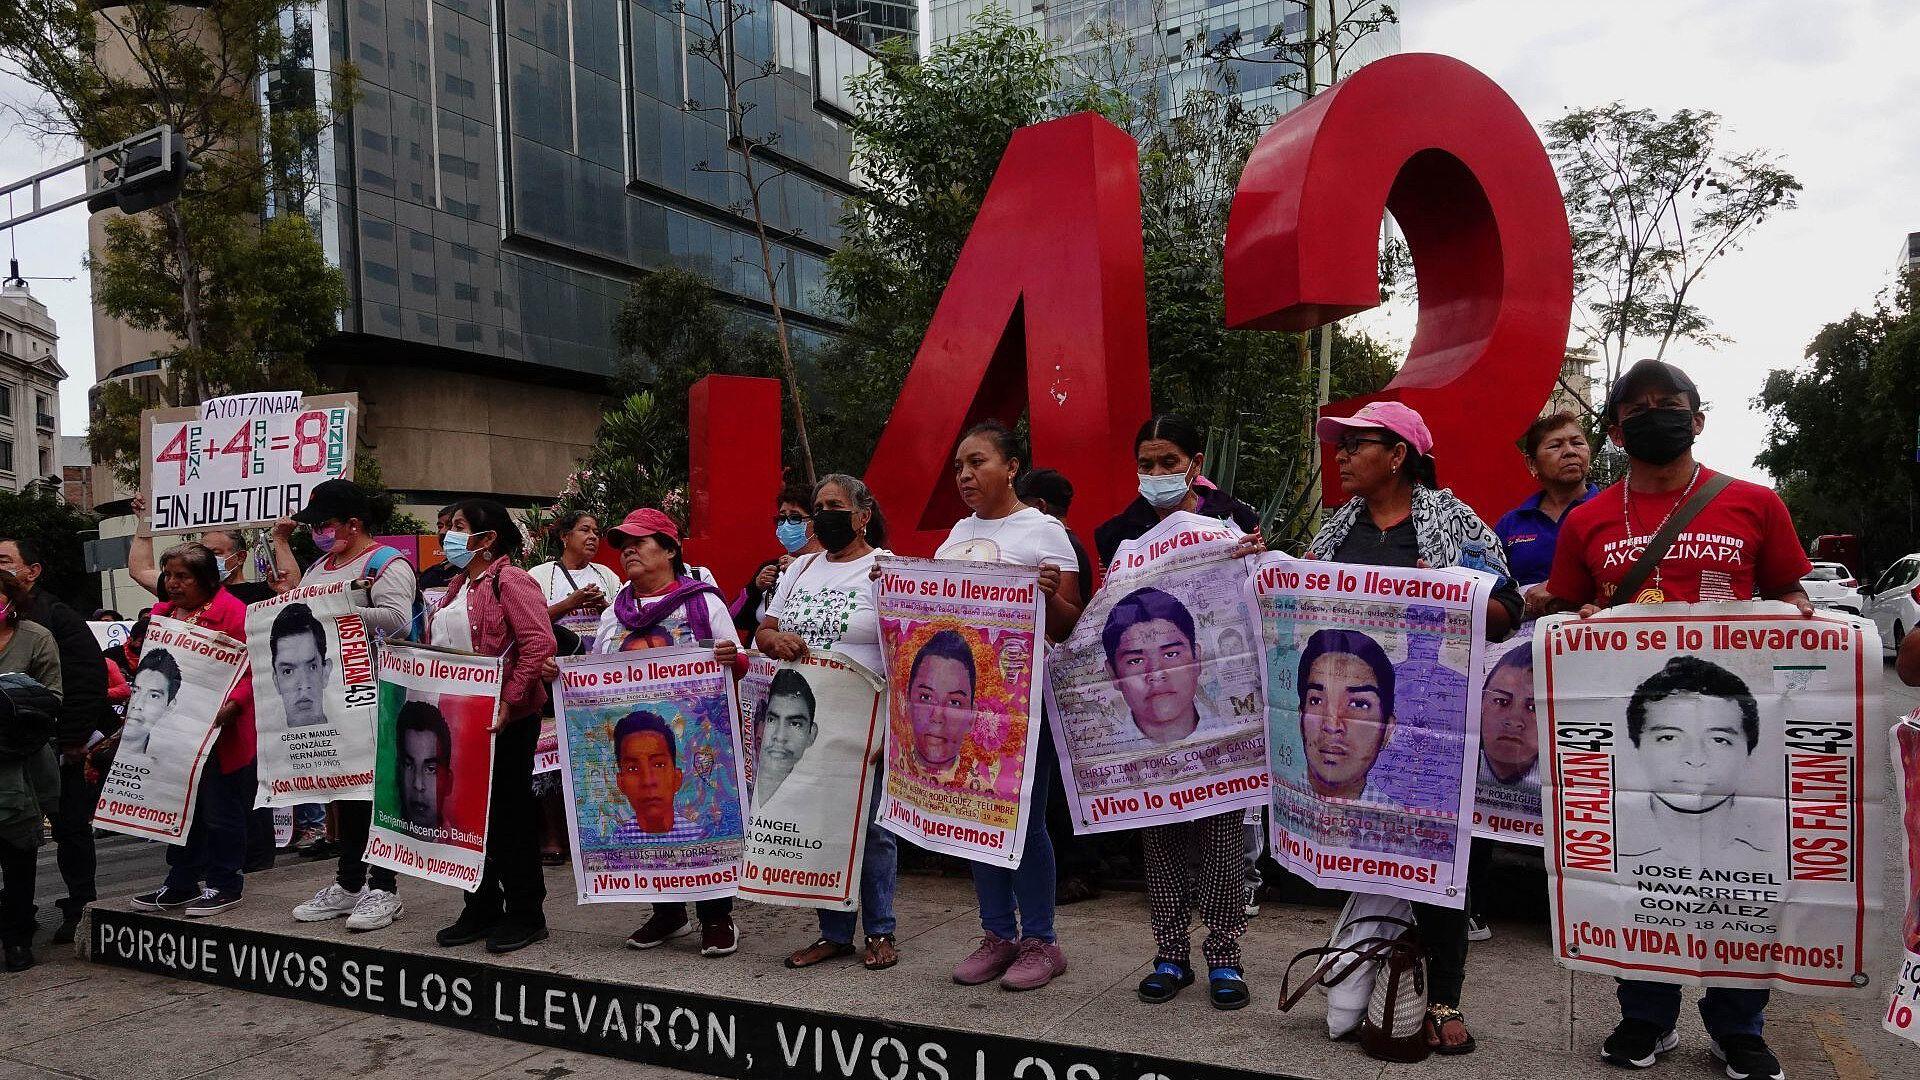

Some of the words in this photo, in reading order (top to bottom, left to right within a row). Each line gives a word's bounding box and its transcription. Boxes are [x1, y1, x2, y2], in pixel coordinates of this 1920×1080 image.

[293, 411, 328, 474] 8
[155, 494, 190, 528] SIN
[193, 484, 302, 525] JUSTICIA
[1127, 553, 1144, 569] lo
[1149, 529, 1234, 561] llevaron!
[1603, 544, 1742, 569] AYOZINAPA
[1604, 541, 1617, 552] NI
[1677, 532, 1693, 542] NI
[1696, 533, 1744, 549] OLVIDO
[880, 573, 916, 596] ¡Vivo
[920, 580, 938, 596] se
[943, 578, 956, 598] lo
[961, 579, 1034, 604] llevaron!
[1257, 567, 1299, 595] ¡Vivo
[1304, 572, 1330, 591] se
[1337, 570, 1357, 593] lo
[1364, 571, 1471, 603] llevaron!
[336, 614, 365, 640] NOS
[1555, 626, 1628, 656] ¡Vivo
[1636, 629, 1667, 651] se
[1677, 625, 1703, 651] lo
[1713, 624, 1849, 651] llevaron!
[150, 629, 160, 641] se
[162, 631, 173, 644] lo
[174, 634, 241, 666] llevaron!
[342, 640, 373, 686] FALTAN
[379, 651, 401, 672] ¡Vivo
[402, 659, 411, 674] se
[412, 660, 425, 676] lo
[429, 659, 500, 684] llevaron!
[562, 671, 598, 691] ¡Vivo
[603, 670, 622, 685] se
[628, 665, 643, 682] lo
[647, 659, 721, 680] llevaron!
[345, 684, 377, 709] 43!
[281, 732, 307, 742] CÉSAR
[308, 729, 340, 739] MANUEL
[289, 739, 332, 750] GONZÁLEZ
[1557, 721, 1614, 753] 43!
[1785, 720, 1853, 754] 43!
[289, 749, 338, 760] HERNÁNDEZ
[293, 762, 312, 770] EDAD
[1079, 762, 1137, 780] CHRISTIAN
[1143, 755, 1178, 769] TOMÁS
[1185, 744, 1221, 762] COLÓN
[272, 779, 294, 795] ¡Con
[293, 775, 316, 791] VIDA
[316, 774, 327, 790] lo
[1562, 752, 1611, 825] FALTAN
[1791, 754, 1848, 831] FALTAN
[109, 800, 178, 825] queremos!
[977, 800, 1015, 815] TELUMBRE
[1090, 795, 1139, 822] ¡Vivo
[1144, 791, 1164, 810] lo
[409, 821, 449, 839] Ascencio
[451, 828, 483, 847] Bautista
[755, 816, 800, 833] ÁNGEL
[889, 799, 911, 823] ¡Vivo
[912, 809, 921, 828] lo
[922, 818, 1005, 849] queremos!
[752, 847, 765, 855] 18
[769, 848, 803, 860] AÑOS
[755, 832, 823, 850] CARRILLO
[1279, 828, 1300, 856] ¡Vivo
[1303, 841, 1313, 863] lo
[1315, 852, 1437, 885] queremos!
[1565, 828, 1613, 873] NOS
[369, 837, 392, 859] ¡Con
[394, 845, 413, 867] Vida
[415, 850, 424, 870] lo
[427, 857, 480, 883] queremos!
[746, 861, 758, 880] lo
[762, 866, 842, 888] queremos!
[1632, 864, 1692, 880] JOSÉ
[1698, 867, 1782, 885] ÁNGEL
[1792, 837, 1848, 881] NOS
[594, 874, 630, 894] ¡Vivo
[634, 873, 648, 889] lo
[652, 866, 738, 893] queremos!
[1637, 880, 1778, 902] NAVARRETE
[1634, 913, 1686, 927] EDAD
[1694, 920, 1715, 930] 18
[1721, 920, 1777, 934] AÑOS
[1640, 897, 1769, 919] GONZÁLEZ
[1572, 921, 1617, 946] ¡Con
[1622, 927, 1681, 956] VIDA
[1687, 933, 1707, 960] lo
[1714, 939, 1844, 970] queremos!
[100, 923, 218, 974] PORQUE
[228, 942, 328, 992] VIVOS
[341, 960, 385, 1002] SE
[400, 968, 473, 1017] LOS
[495, 981, 753, 1070] LLEVARON,
[776, 1021, 949, 1080] VIVOS
